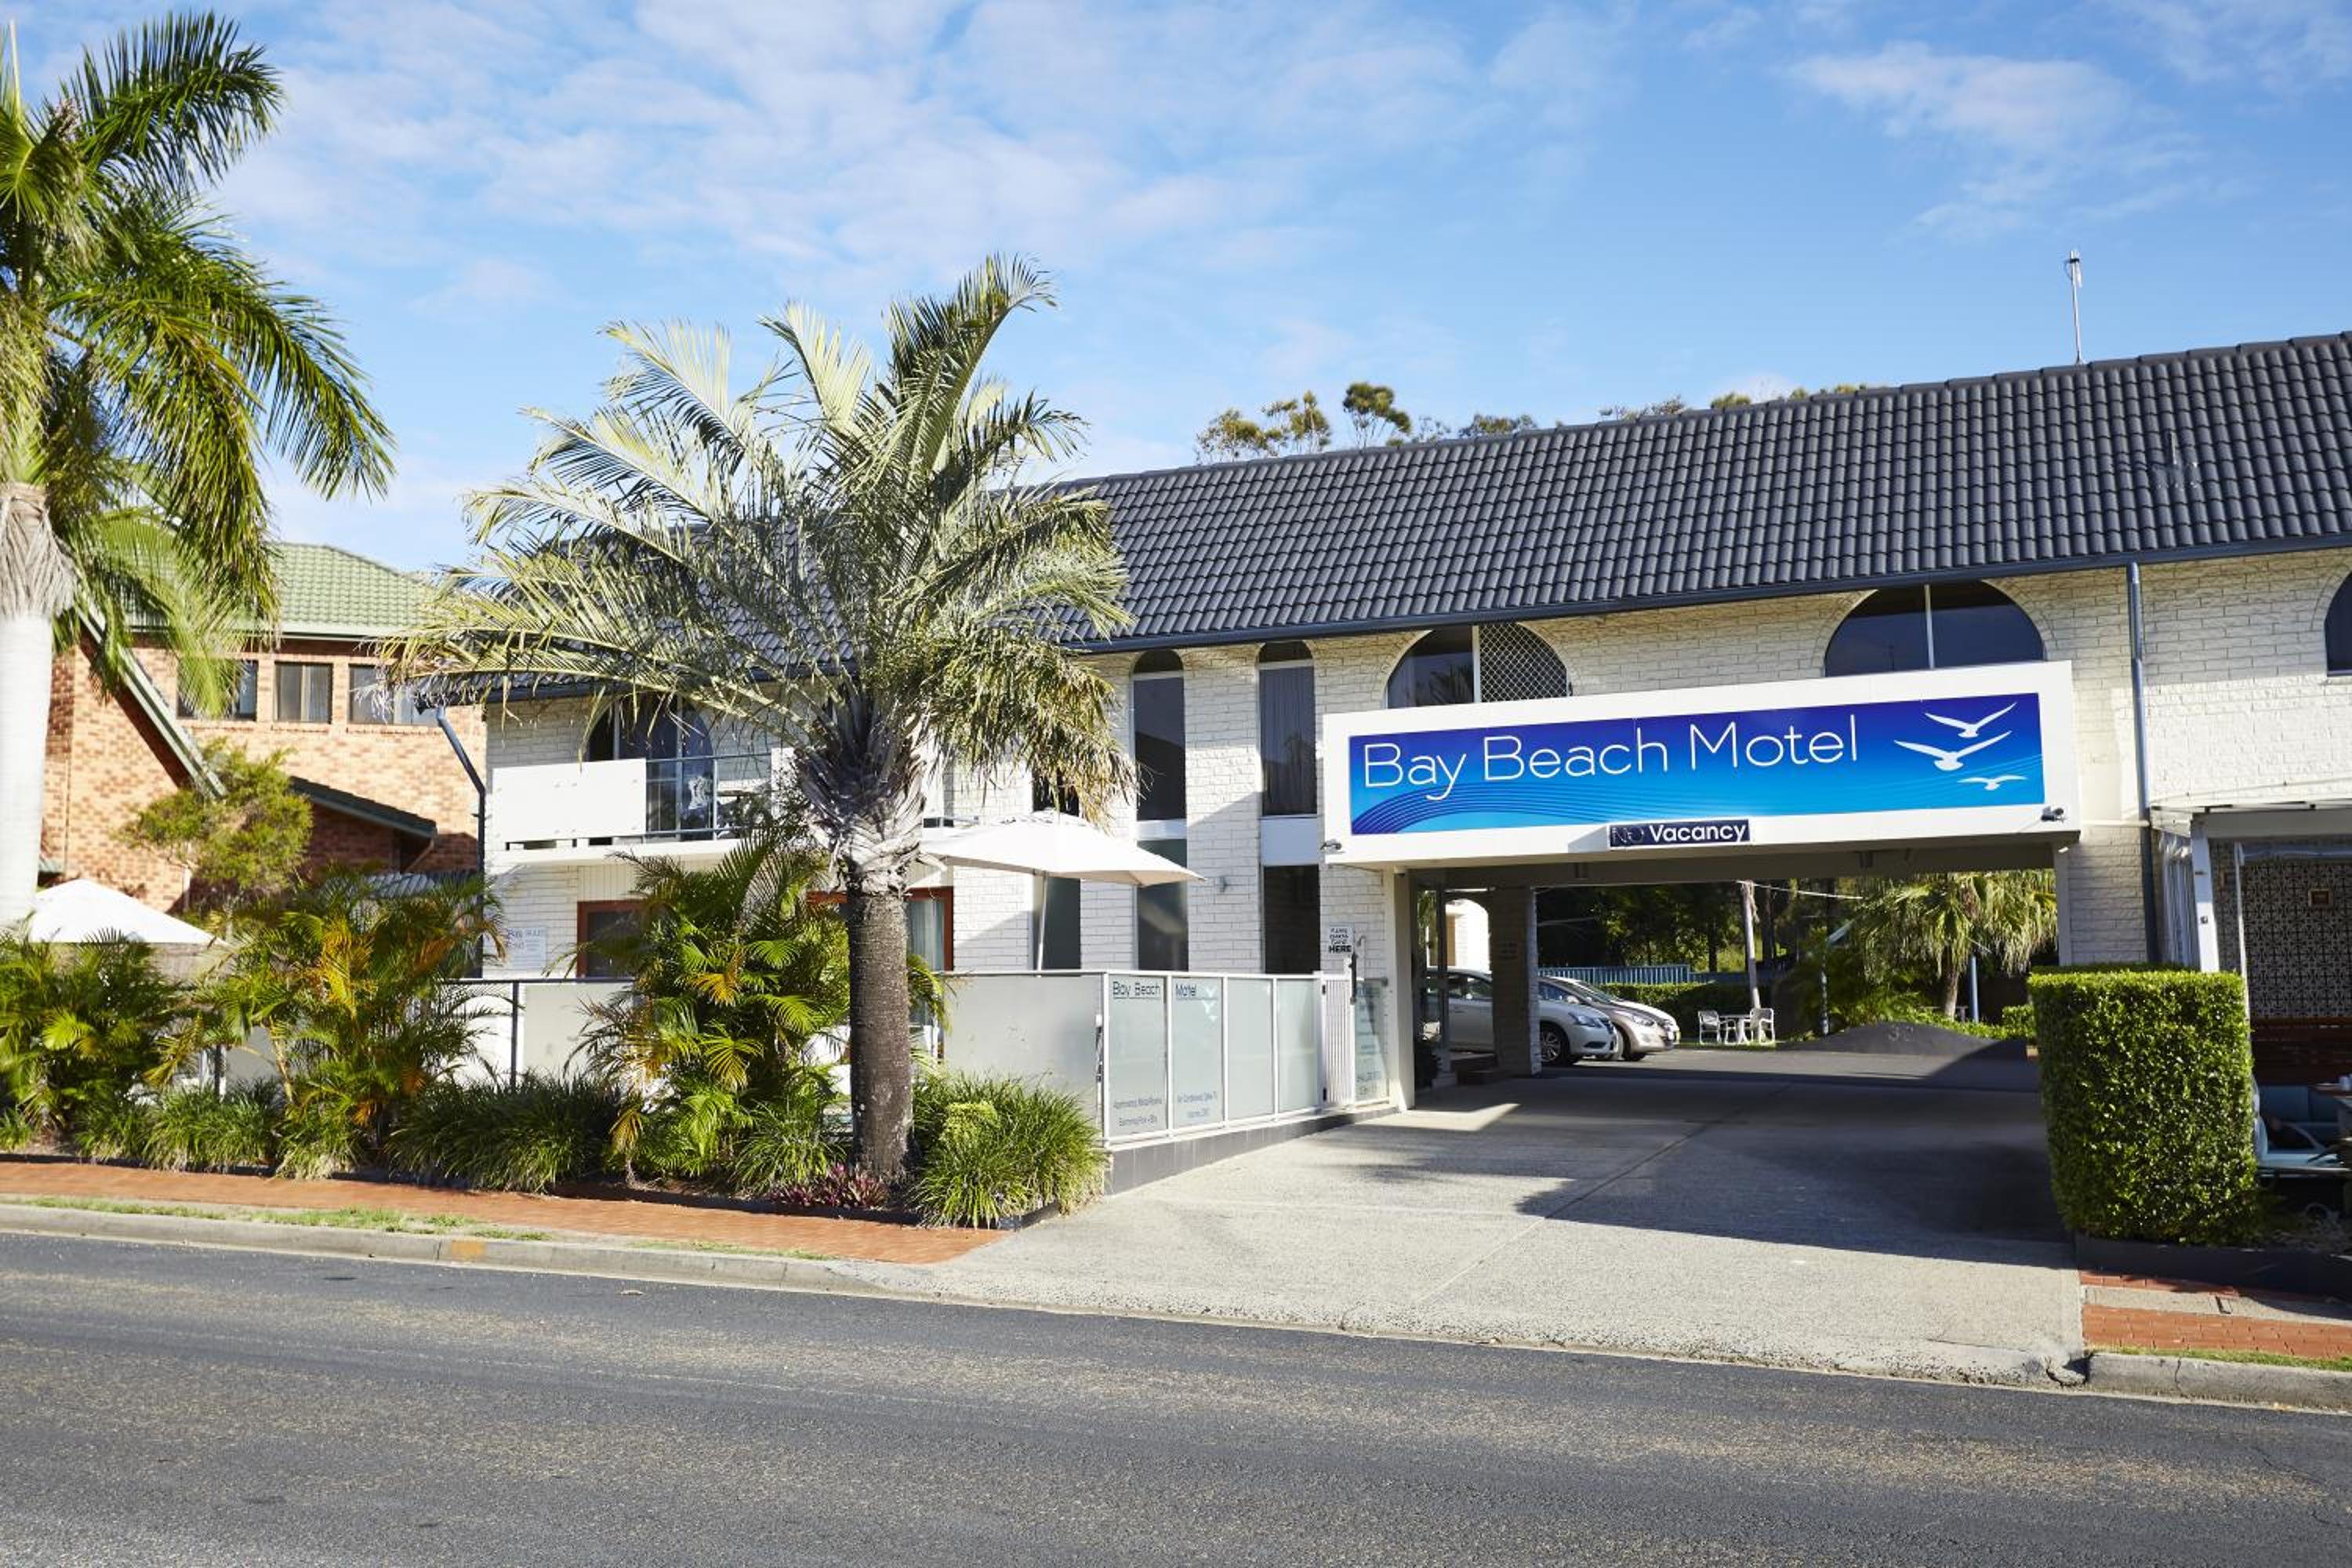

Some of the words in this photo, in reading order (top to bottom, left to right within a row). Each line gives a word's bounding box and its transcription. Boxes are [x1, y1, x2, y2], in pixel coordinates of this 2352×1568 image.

[1364, 742, 1467, 800] Bay
[1483, 727, 1668, 781] Beach
[1690, 714, 1857, 771] Motel
[1649, 824, 1747, 843] Vacancy
[1329, 945, 1352, 953] HERE
[1112, 981, 1131, 997] Bay
[1134, 982, 1160, 996] Beach
[1175, 984, 1196, 996] Motel
